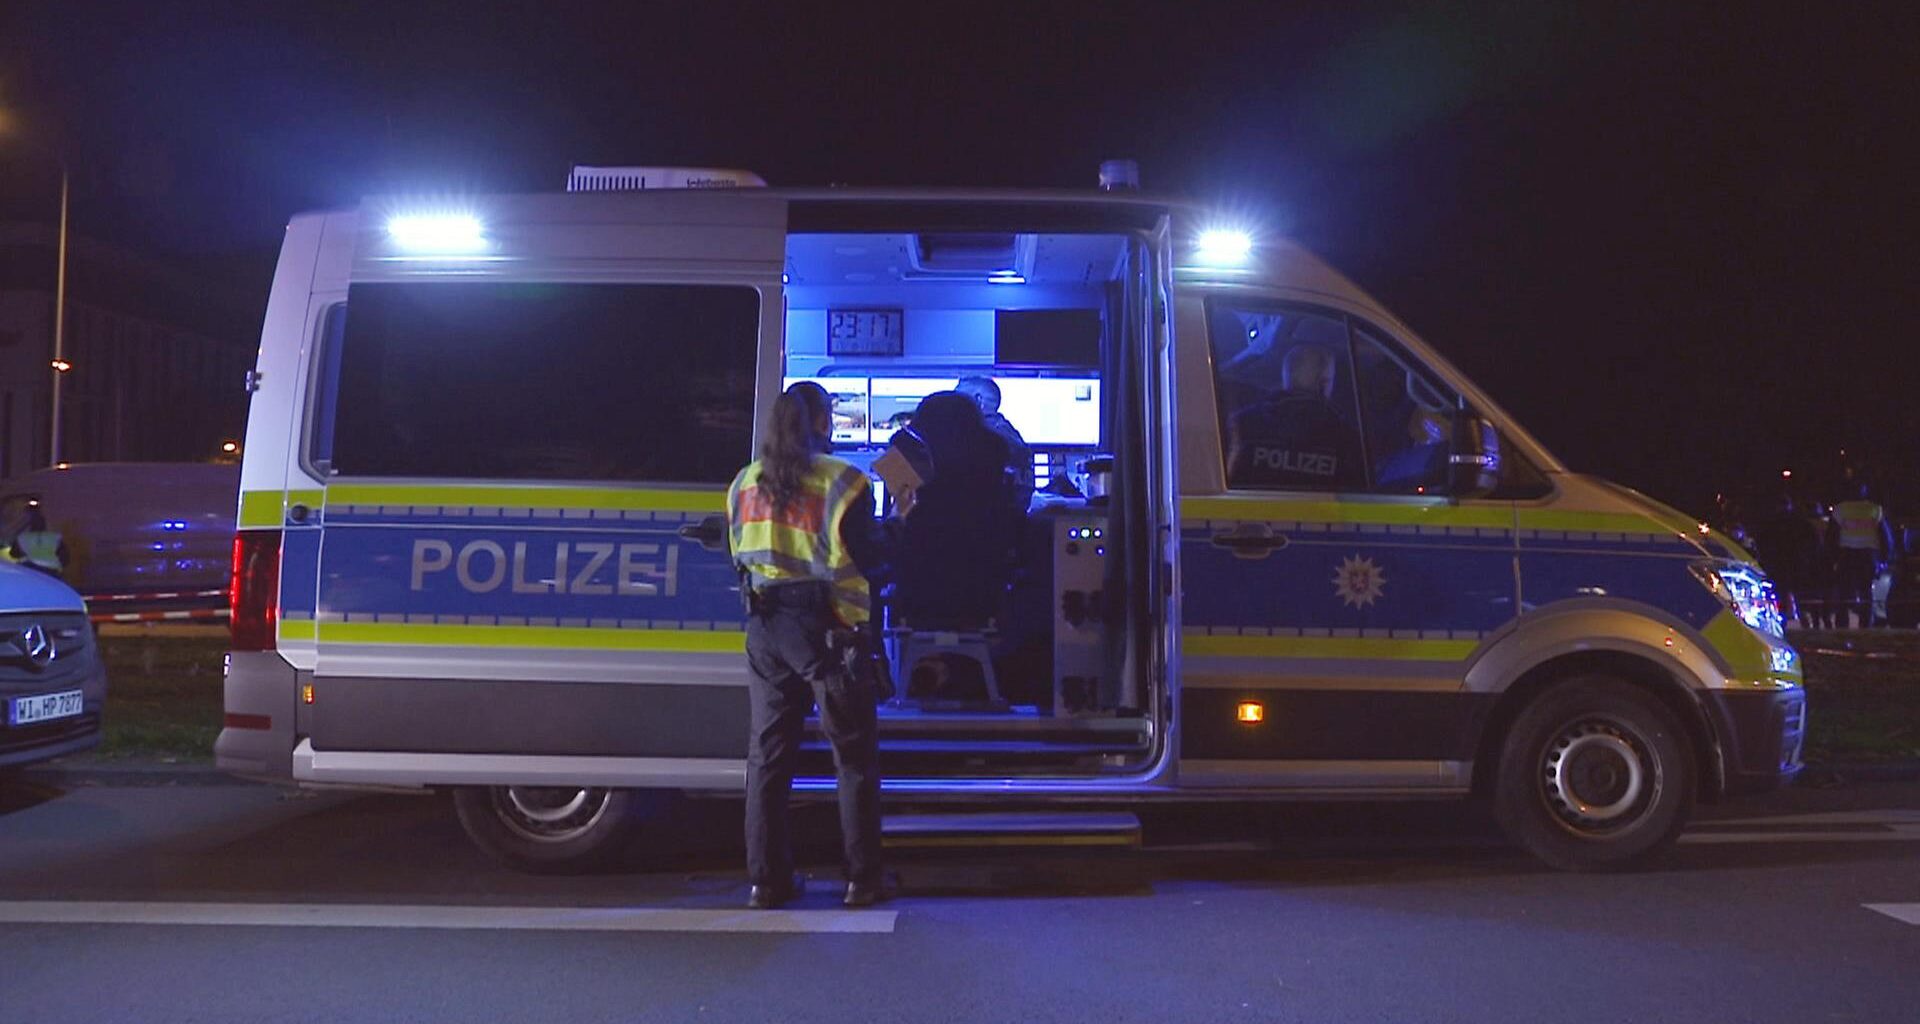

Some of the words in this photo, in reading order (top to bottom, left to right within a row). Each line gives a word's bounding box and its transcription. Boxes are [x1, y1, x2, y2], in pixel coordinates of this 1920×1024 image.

[832, 314, 889, 338] 23:17
[1252, 446, 1338, 477] POLIZEI
[410, 538, 679, 597] POLIZEI
